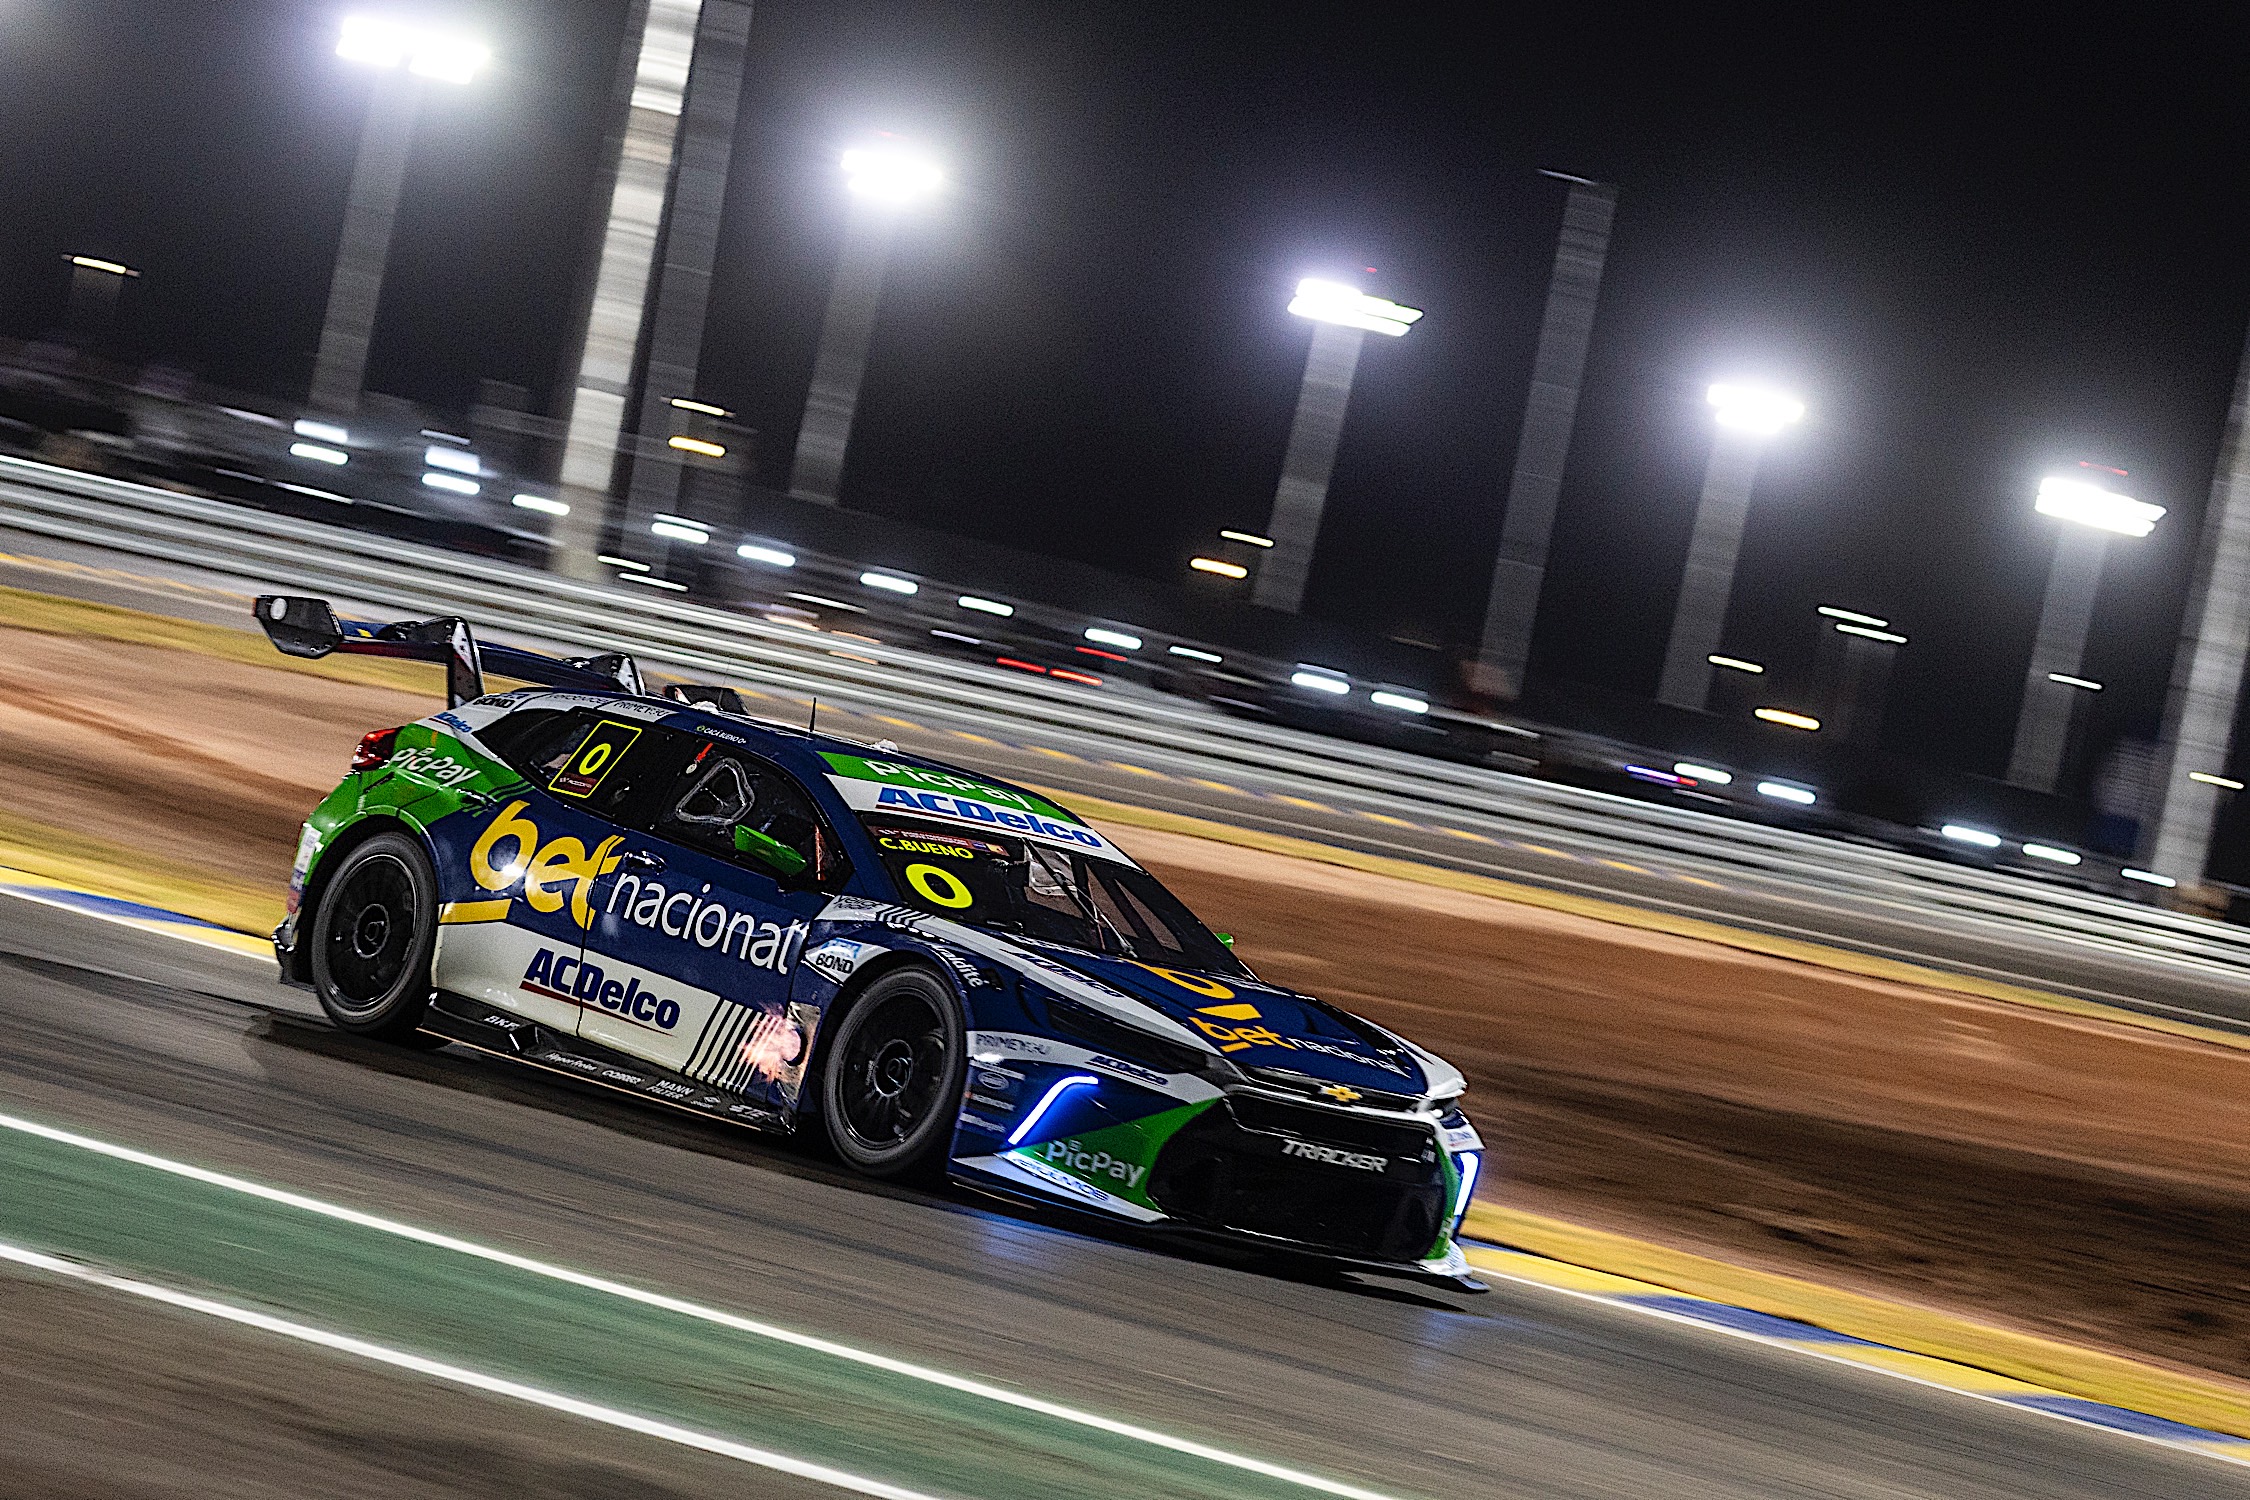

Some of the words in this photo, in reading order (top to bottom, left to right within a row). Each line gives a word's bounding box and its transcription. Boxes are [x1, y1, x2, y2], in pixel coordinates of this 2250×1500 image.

[578, 743, 612, 776] 0
[863, 760, 1035, 810] PicPay
[878, 787, 1102, 848] ACDelco
[879, 837, 974, 859] C.BUENO
[470, 799, 627, 931] bet
[606, 872, 801, 975] nacional
[905, 863, 973, 909] 0
[816, 953, 854, 974] BOND
[523, 948, 680, 1029] ACDelco
[655, 1079, 695, 1096] MANN
[1045, 1139, 1146, 1188] PicPay
[1281, 1138, 1389, 1173] TRACKER
